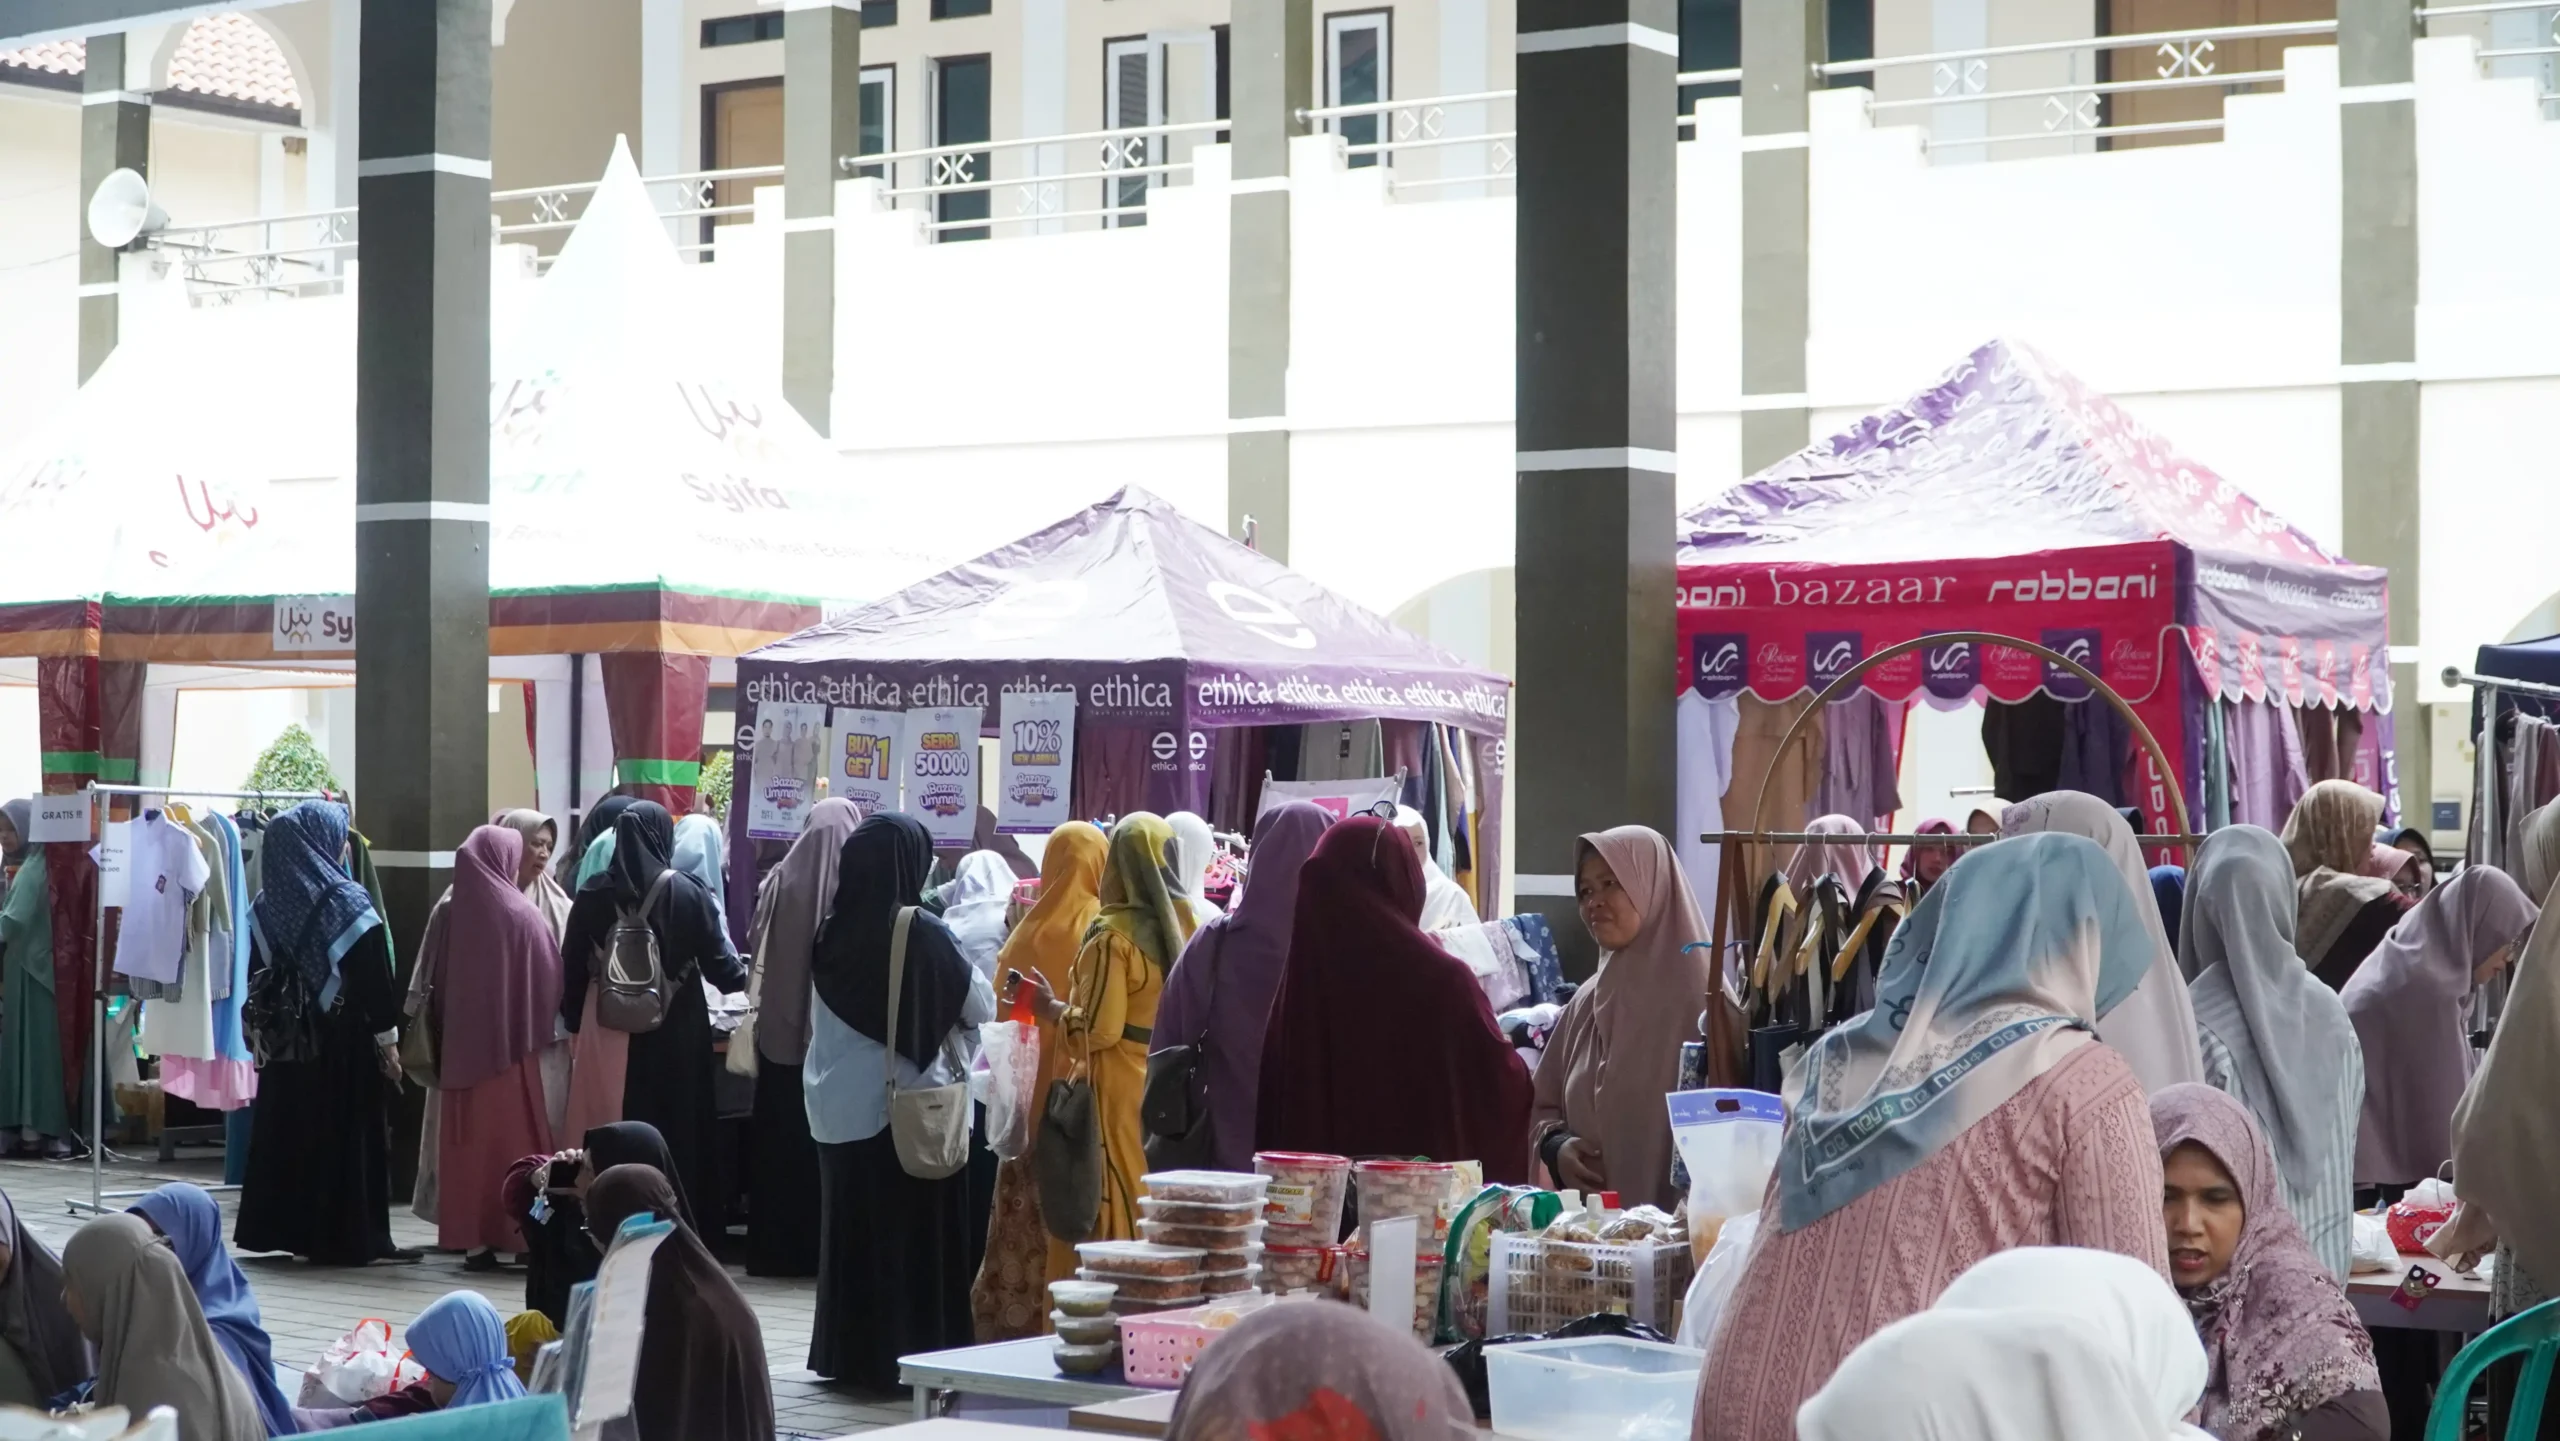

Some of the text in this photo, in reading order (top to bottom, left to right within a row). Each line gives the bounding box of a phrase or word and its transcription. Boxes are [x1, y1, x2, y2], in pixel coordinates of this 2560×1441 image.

[681, 472, 790, 513] Syifa
[1769, 568, 1957, 606] bazaar
[1987, 564, 2157, 602] rabbani
[322, 611, 353, 643] Sy
[746, 672, 818, 702] ethica
[827, 673, 900, 706] ethica
[912, 674, 989, 707] ethica
[1090, 673, 1172, 707] ethica
[1198, 673, 1505, 719] ethica ethica ethica ethica ethica
[846, 733, 877, 756] BUY
[921, 732, 960, 750] SERBA
[1013, 719, 1062, 753] 10%
[845, 756, 873, 779] GET
[876, 736, 891, 780] 1
[915, 752, 970, 776] 50.000
[1151, 762, 1178, 771] ethica
[771, 776, 804, 788] Bazaar
[927, 782, 963, 795] Bazaar
[1016, 772, 1051, 785] Bazaar
[847, 787, 881, 801] Bazaar
[1008, 785, 1058, 800] Ramadhan
[42, 811, 74, 820] GRATIS
